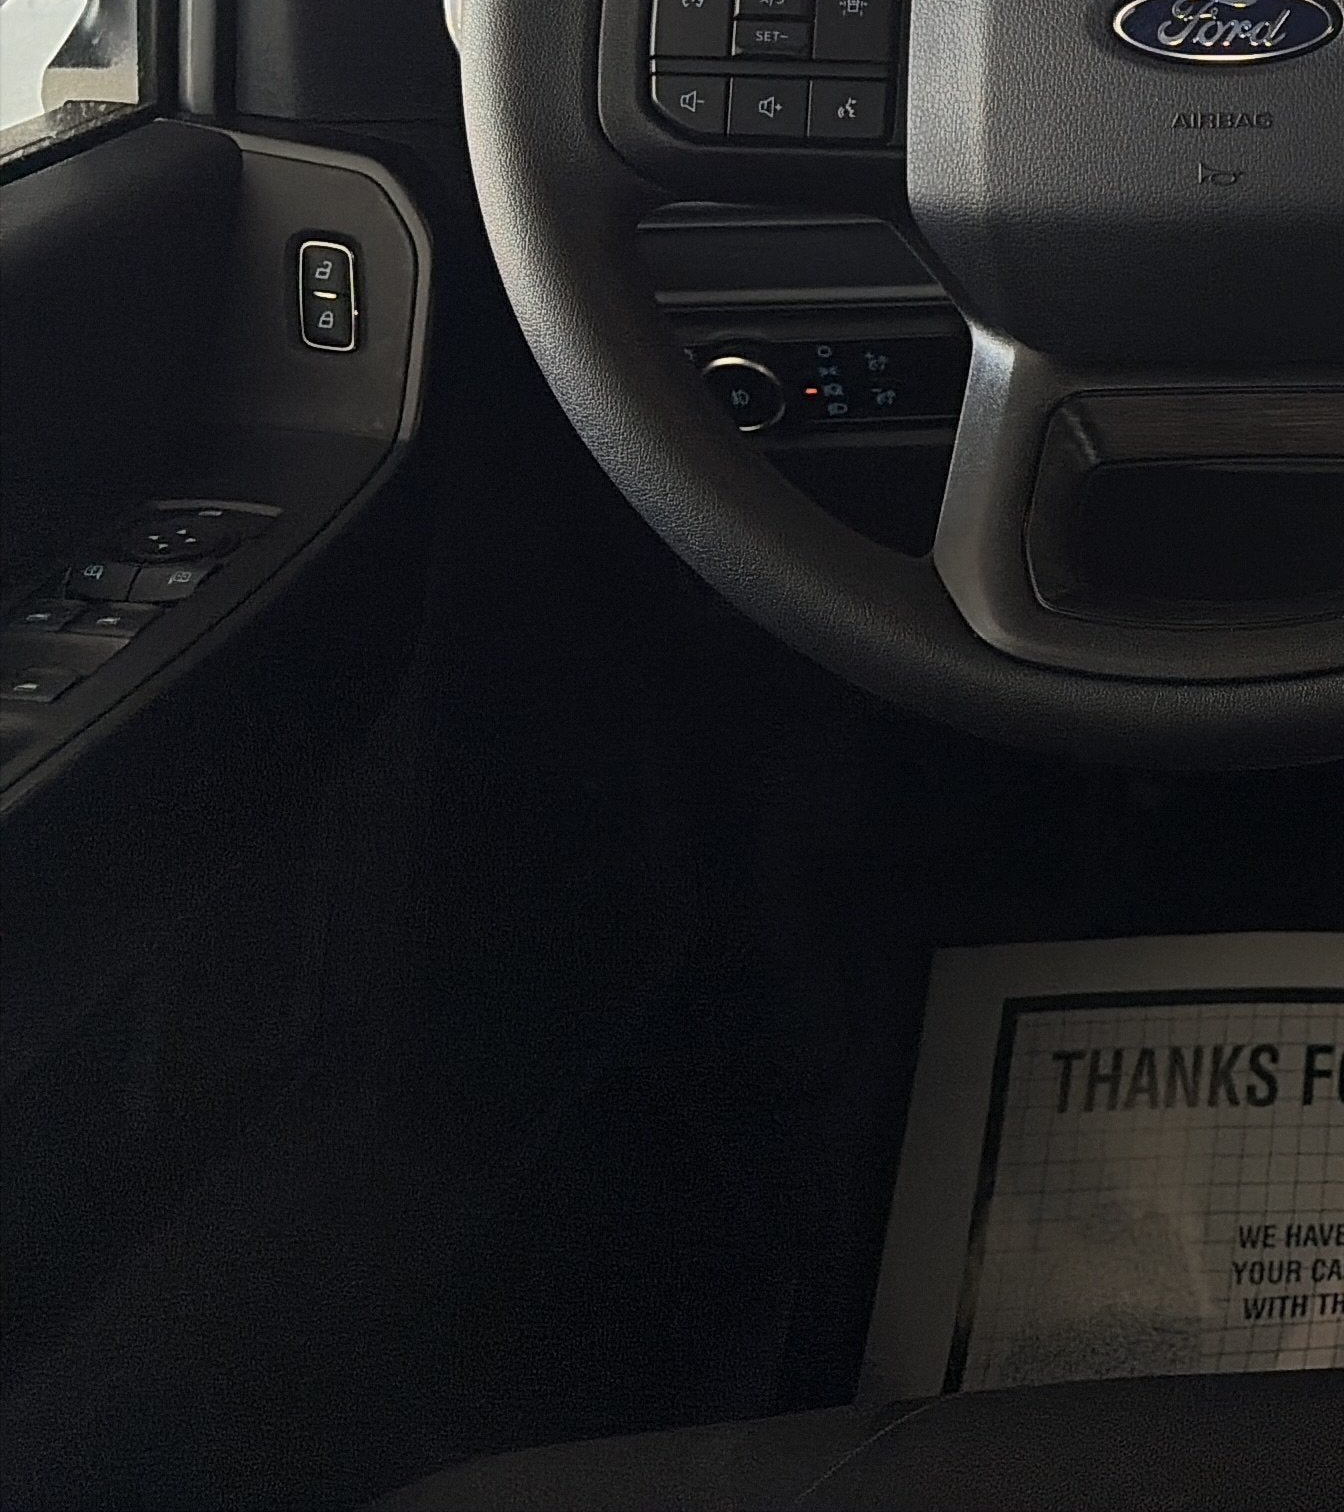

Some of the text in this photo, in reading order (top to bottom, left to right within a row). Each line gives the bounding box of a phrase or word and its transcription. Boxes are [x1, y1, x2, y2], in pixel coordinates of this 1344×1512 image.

[1171, 111, 1273, 129] AIRBAG
[1052, 1043, 1279, 1114] THANKS
[1238, 1224, 1277, 1249] WE
[1232, 1260, 1301, 1285] YOUR
[1243, 1294, 1308, 1320] WITH
